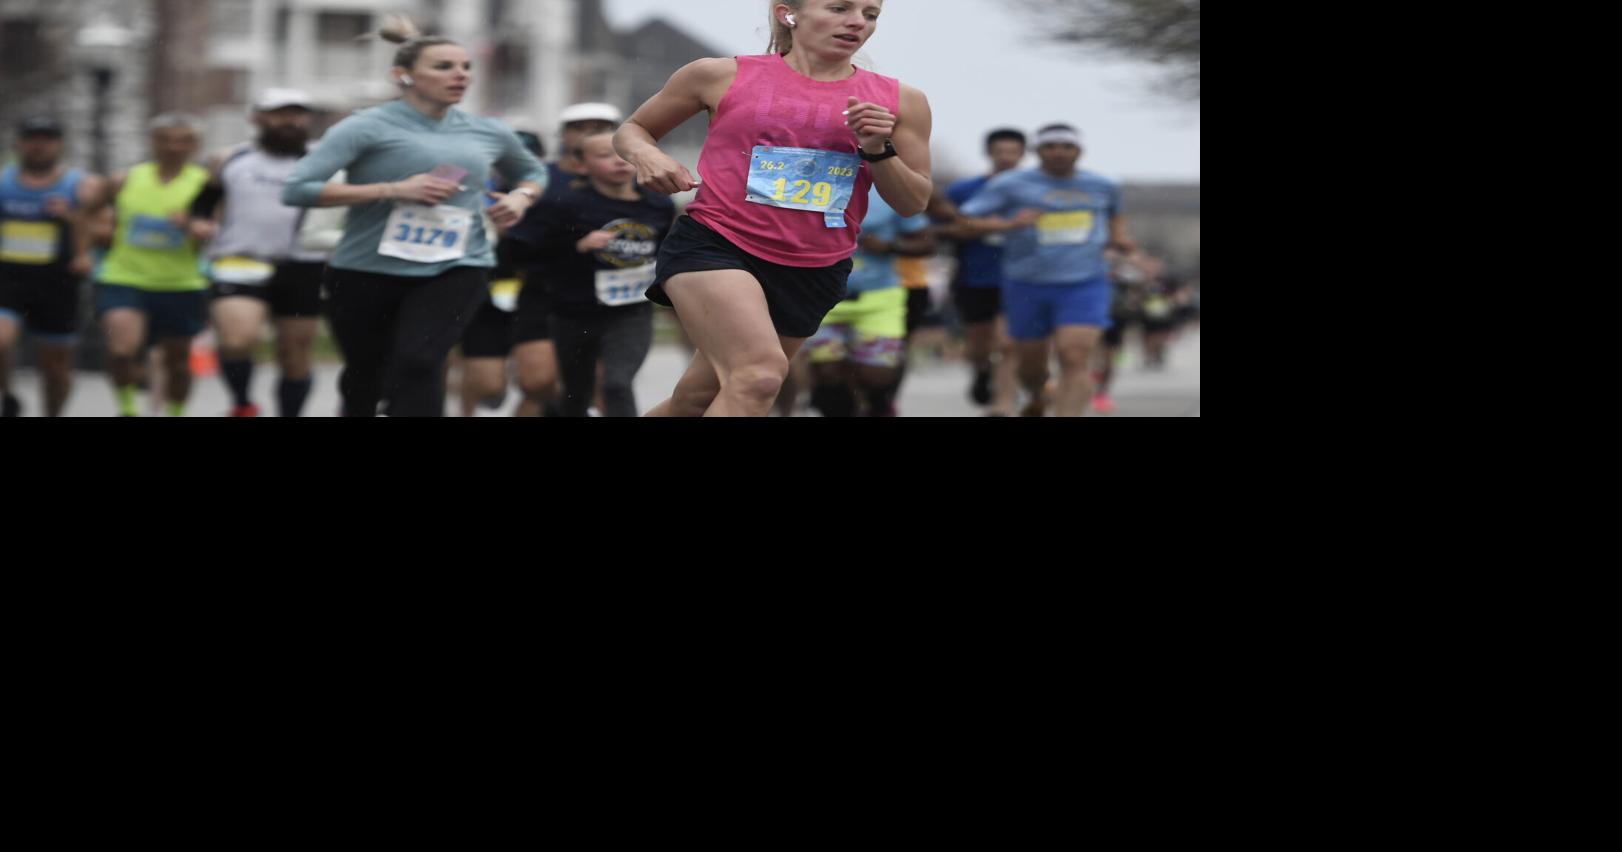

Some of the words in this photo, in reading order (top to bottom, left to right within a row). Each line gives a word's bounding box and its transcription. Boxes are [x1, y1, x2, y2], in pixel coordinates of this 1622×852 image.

[760, 160, 785, 170] 26.2
[827, 166, 853, 177] 2023
[771, 177, 831, 206] 129
